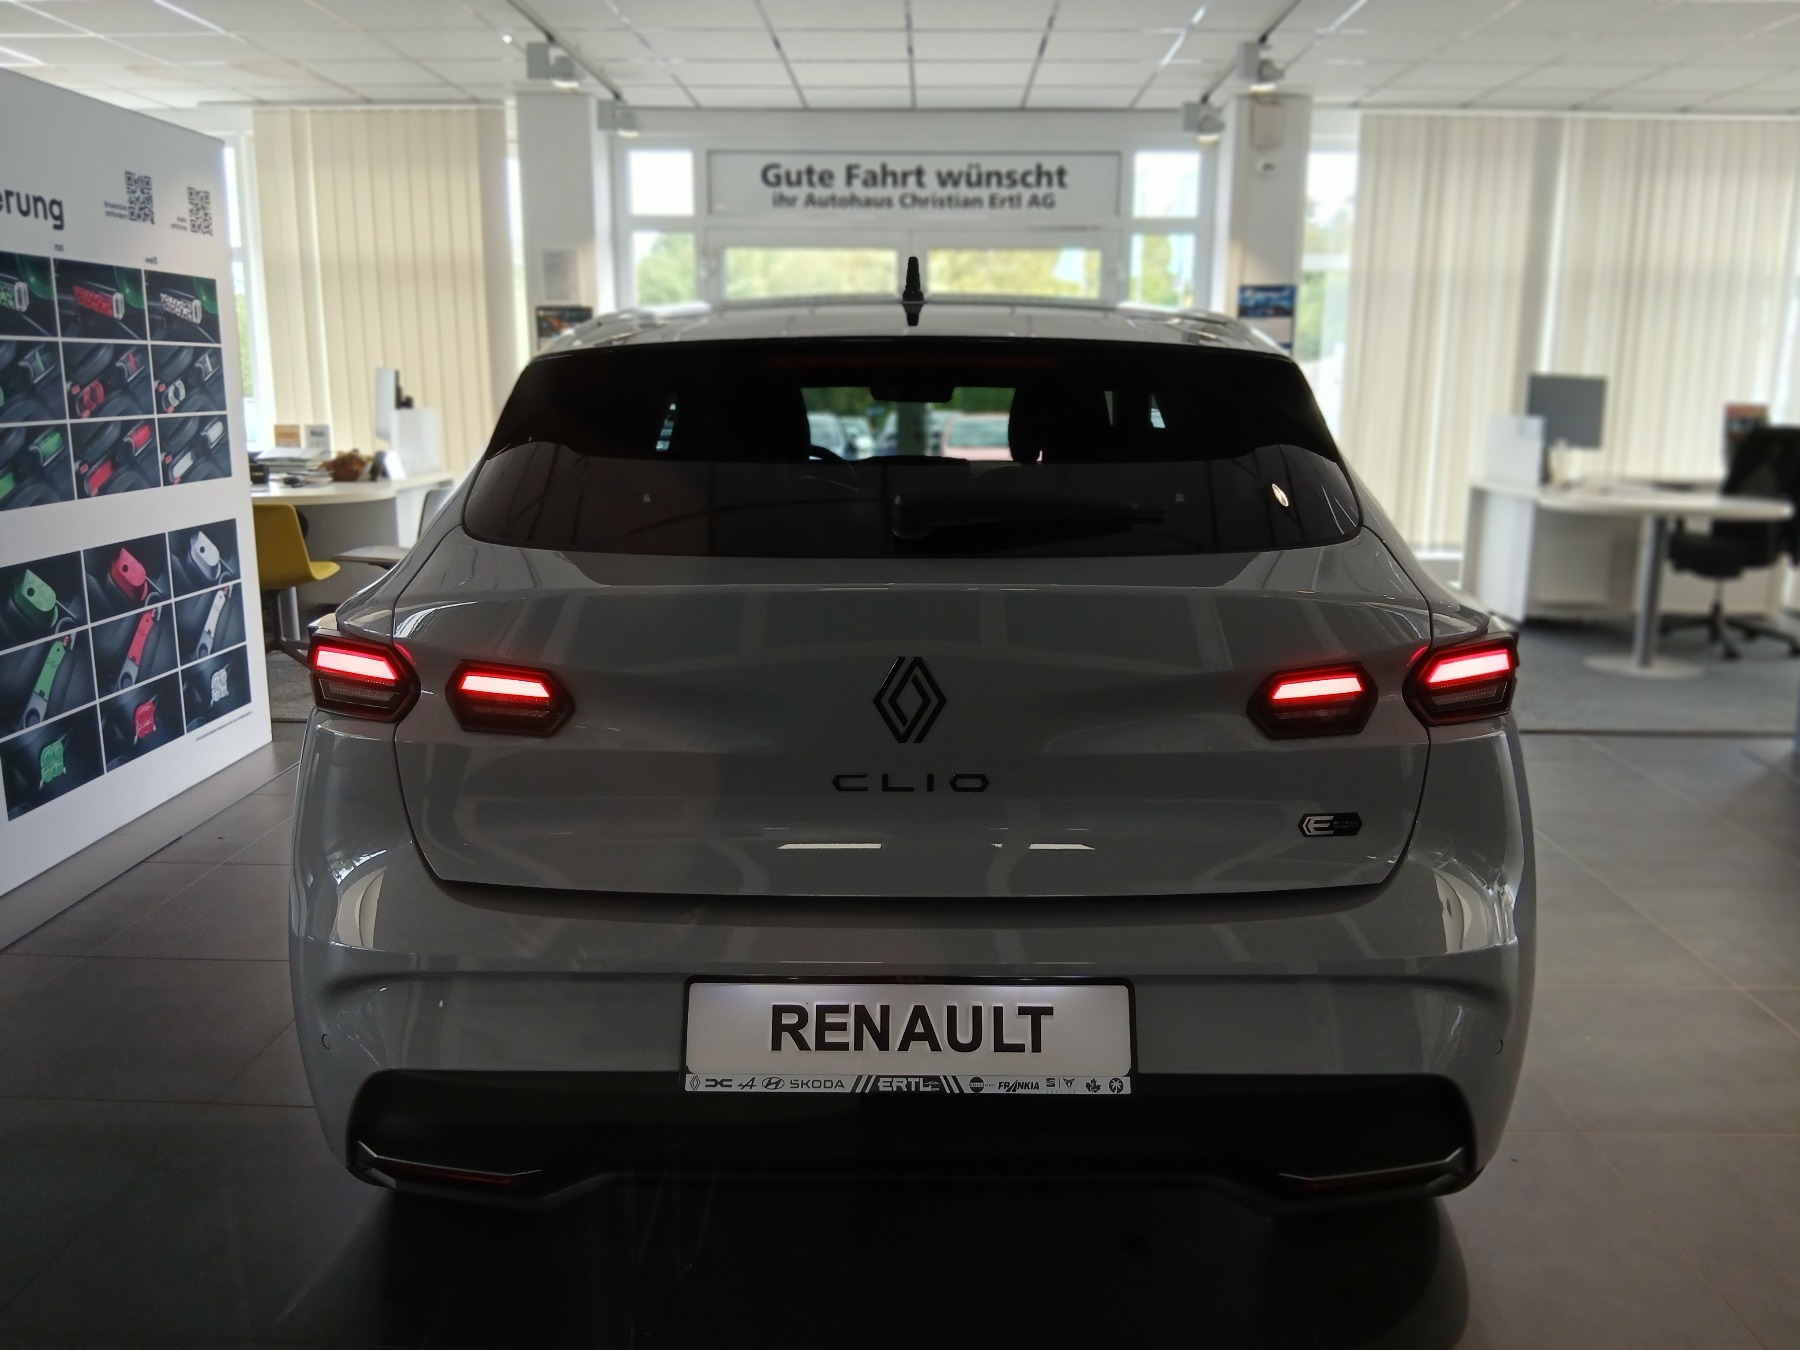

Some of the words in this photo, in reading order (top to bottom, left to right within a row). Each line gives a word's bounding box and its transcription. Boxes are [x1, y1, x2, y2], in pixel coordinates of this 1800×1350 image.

[761, 163, 834, 189] Gute
[844, 162, 927, 189] Fahrt
[936, 162, 1069, 189] wünscht
[804, 192, 894, 210] Autohaus
[899, 192, 984, 210] Christian
[988, 192, 1022, 210] Ertl
[1027, 193, 1056, 209] AG
[832, 773, 990, 793] CLIO
[771, 1004, 1054, 1053] RENAULT
[998, 1079, 1040, 1092] FRANKIA
